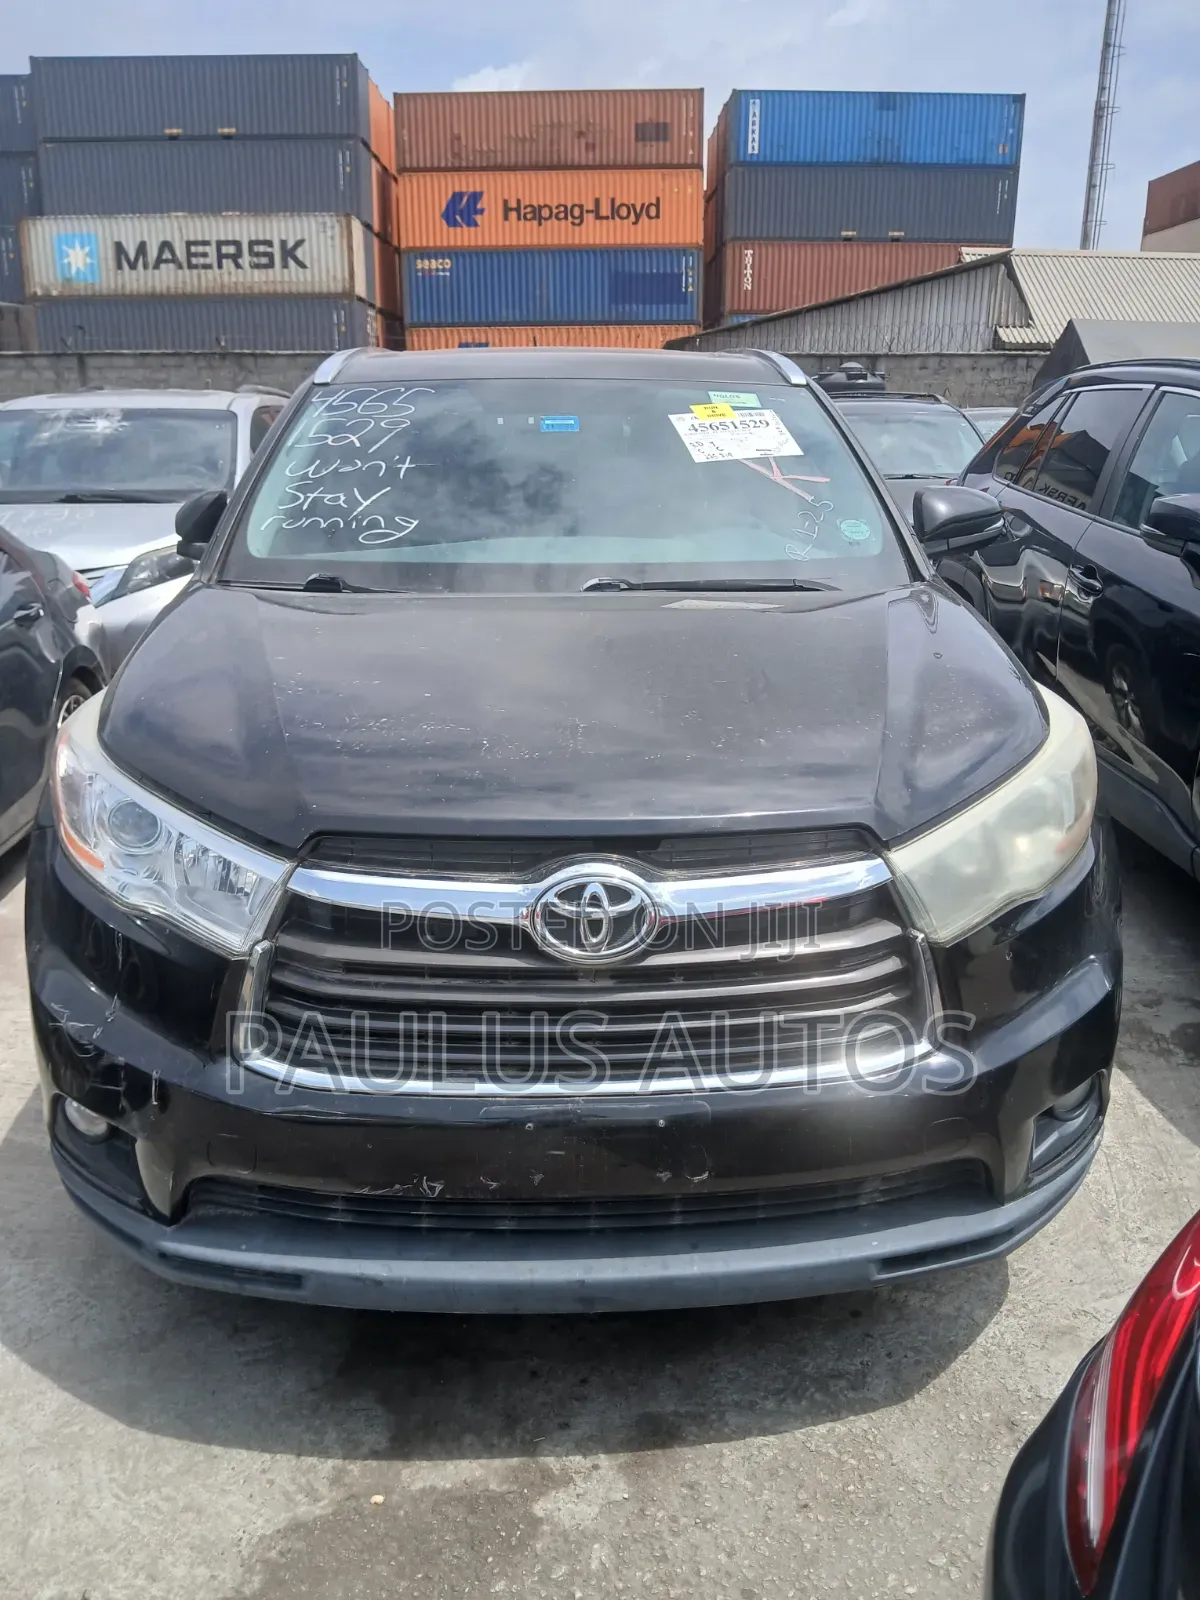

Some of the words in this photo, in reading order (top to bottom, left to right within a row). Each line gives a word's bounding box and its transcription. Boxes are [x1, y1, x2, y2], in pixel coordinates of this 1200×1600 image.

[503, 197, 661, 226] Hapag-Lloyd
[114, 238, 308, 271] MAERSK
[416, 259, 451, 269] seaco
[744, 249, 753, 290] TRITON
[311, 387, 436, 417] 4565
[288, 418, 411, 453] 1529
[688, 419, 770, 433] 45651529
[260, 515, 419, 544] running
